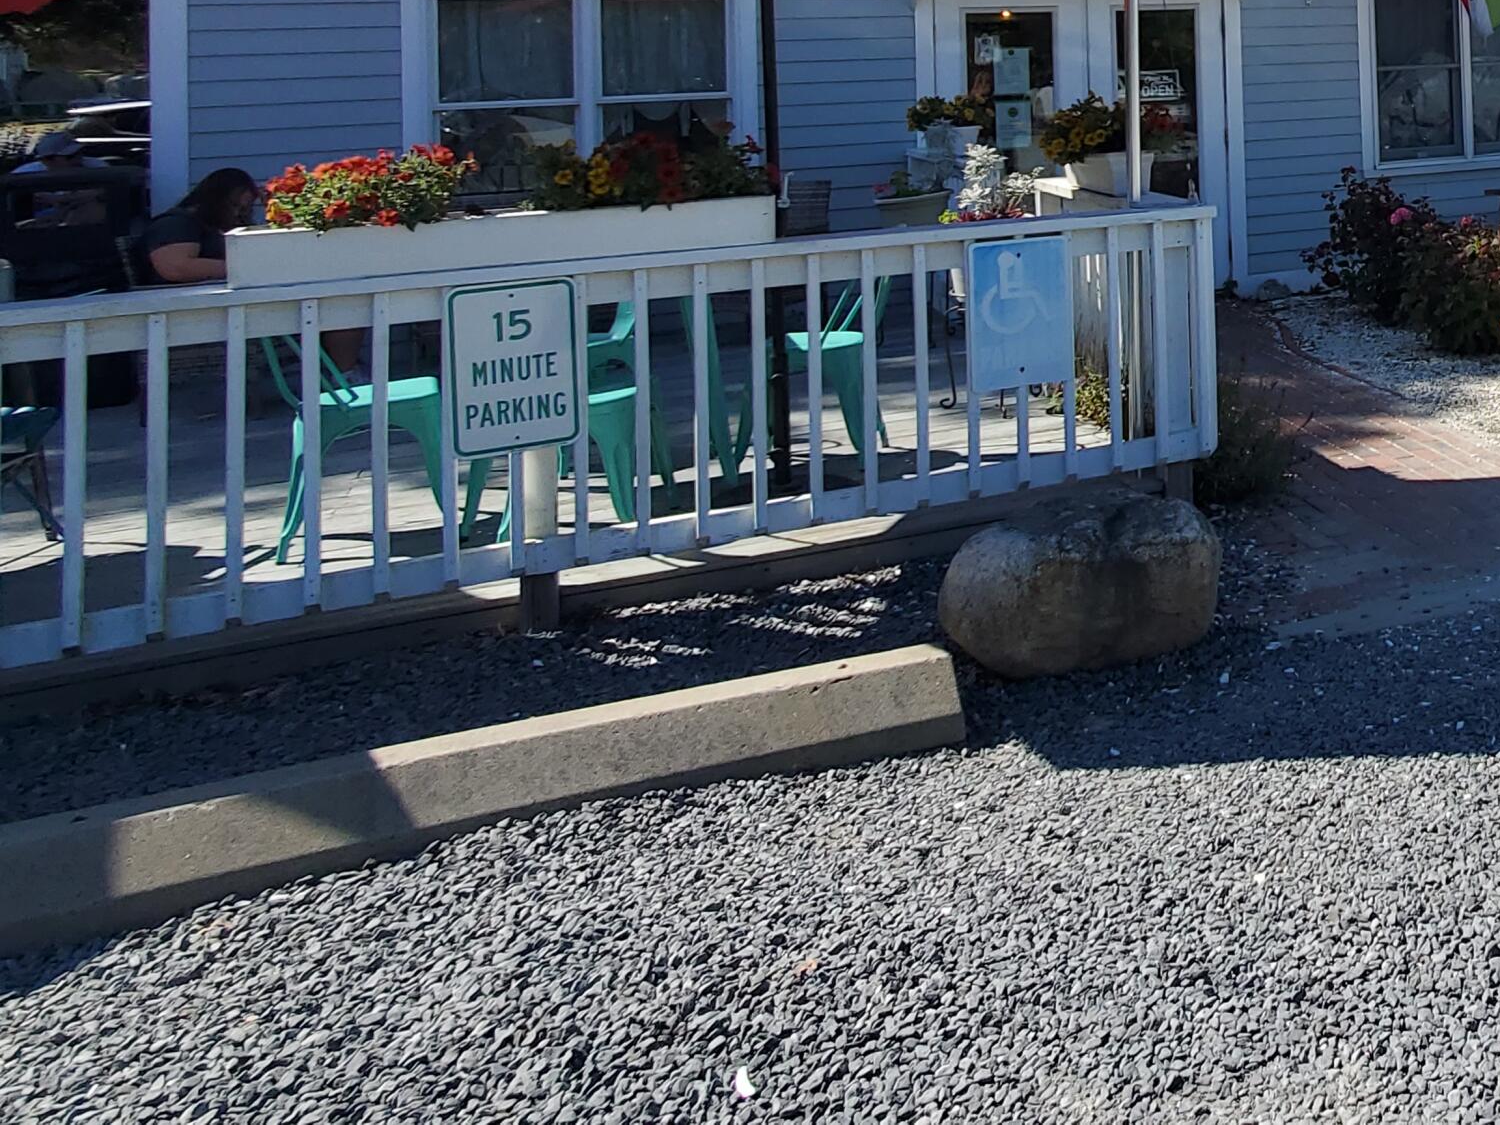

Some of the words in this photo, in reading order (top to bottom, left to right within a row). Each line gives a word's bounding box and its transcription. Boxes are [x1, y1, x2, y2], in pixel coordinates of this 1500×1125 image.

[1142, 83, 1173, 97] OPEN
[492, 309, 532, 342] 15
[472, 351, 558, 387] MINUTE
[465, 392, 567, 430] PARKING
